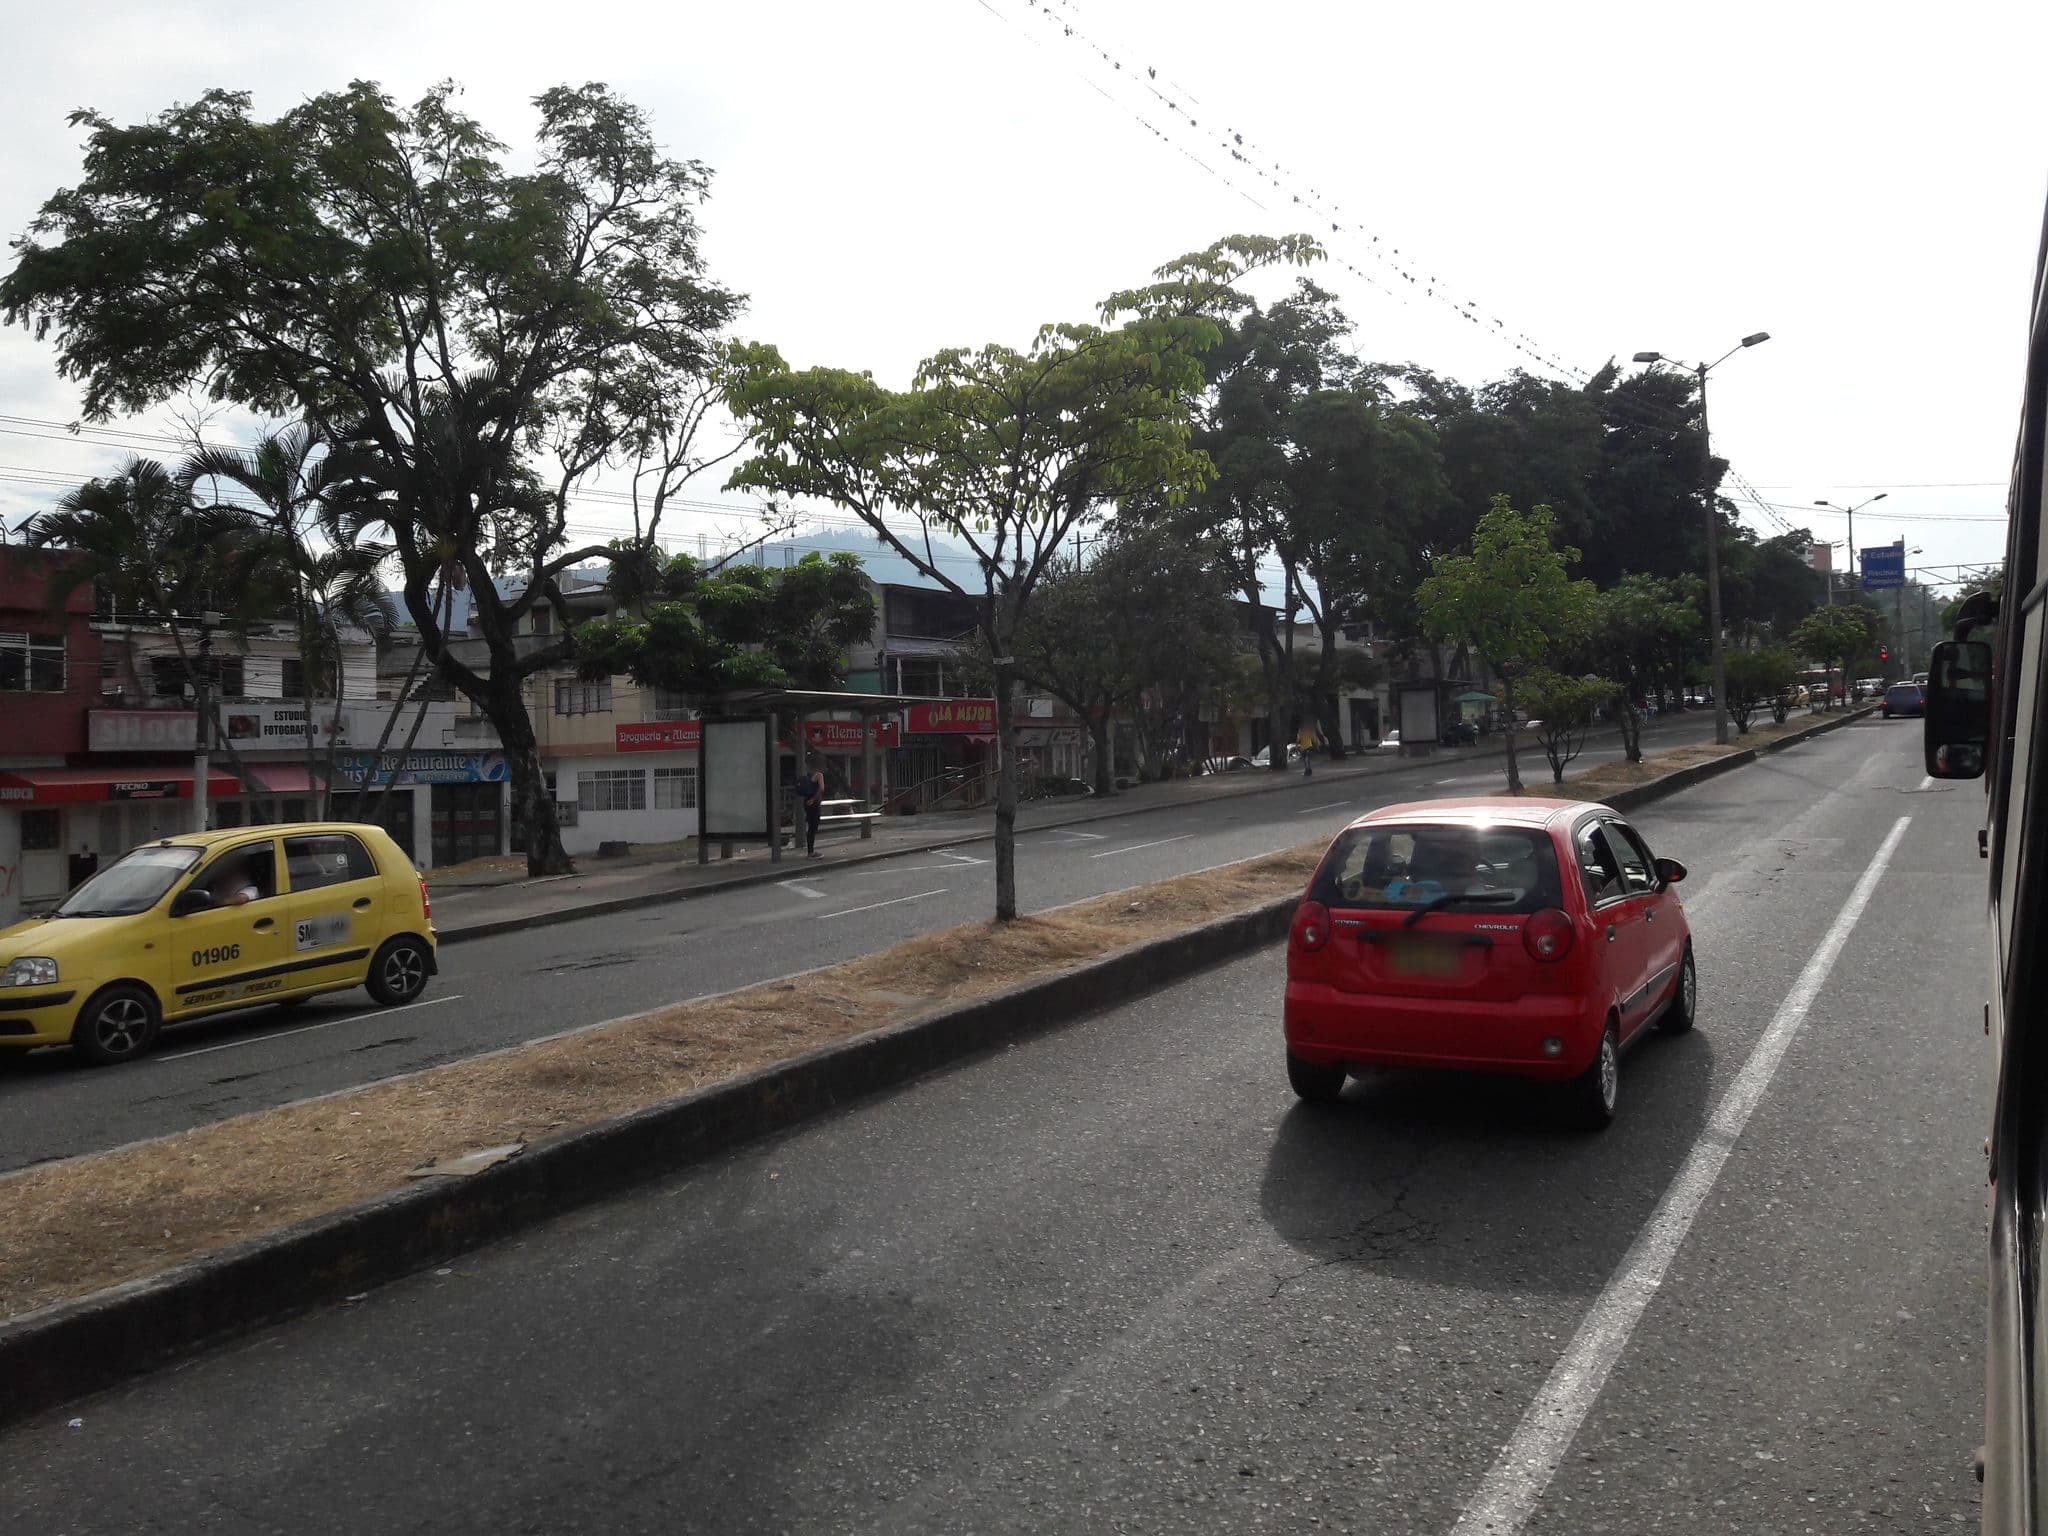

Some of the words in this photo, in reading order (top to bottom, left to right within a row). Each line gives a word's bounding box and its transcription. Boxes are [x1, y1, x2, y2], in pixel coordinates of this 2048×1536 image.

[939, 704, 952, 720] LA
[957, 705, 992, 721] MEJOR
[264, 724, 318, 736] FOTOGRAFO
[827, 724, 877, 739] Alemaa
[114, 782, 149, 791] TECNO
[1473, 923, 1519, 931] CHEVROLET
[191, 943, 241, 968] 01906
